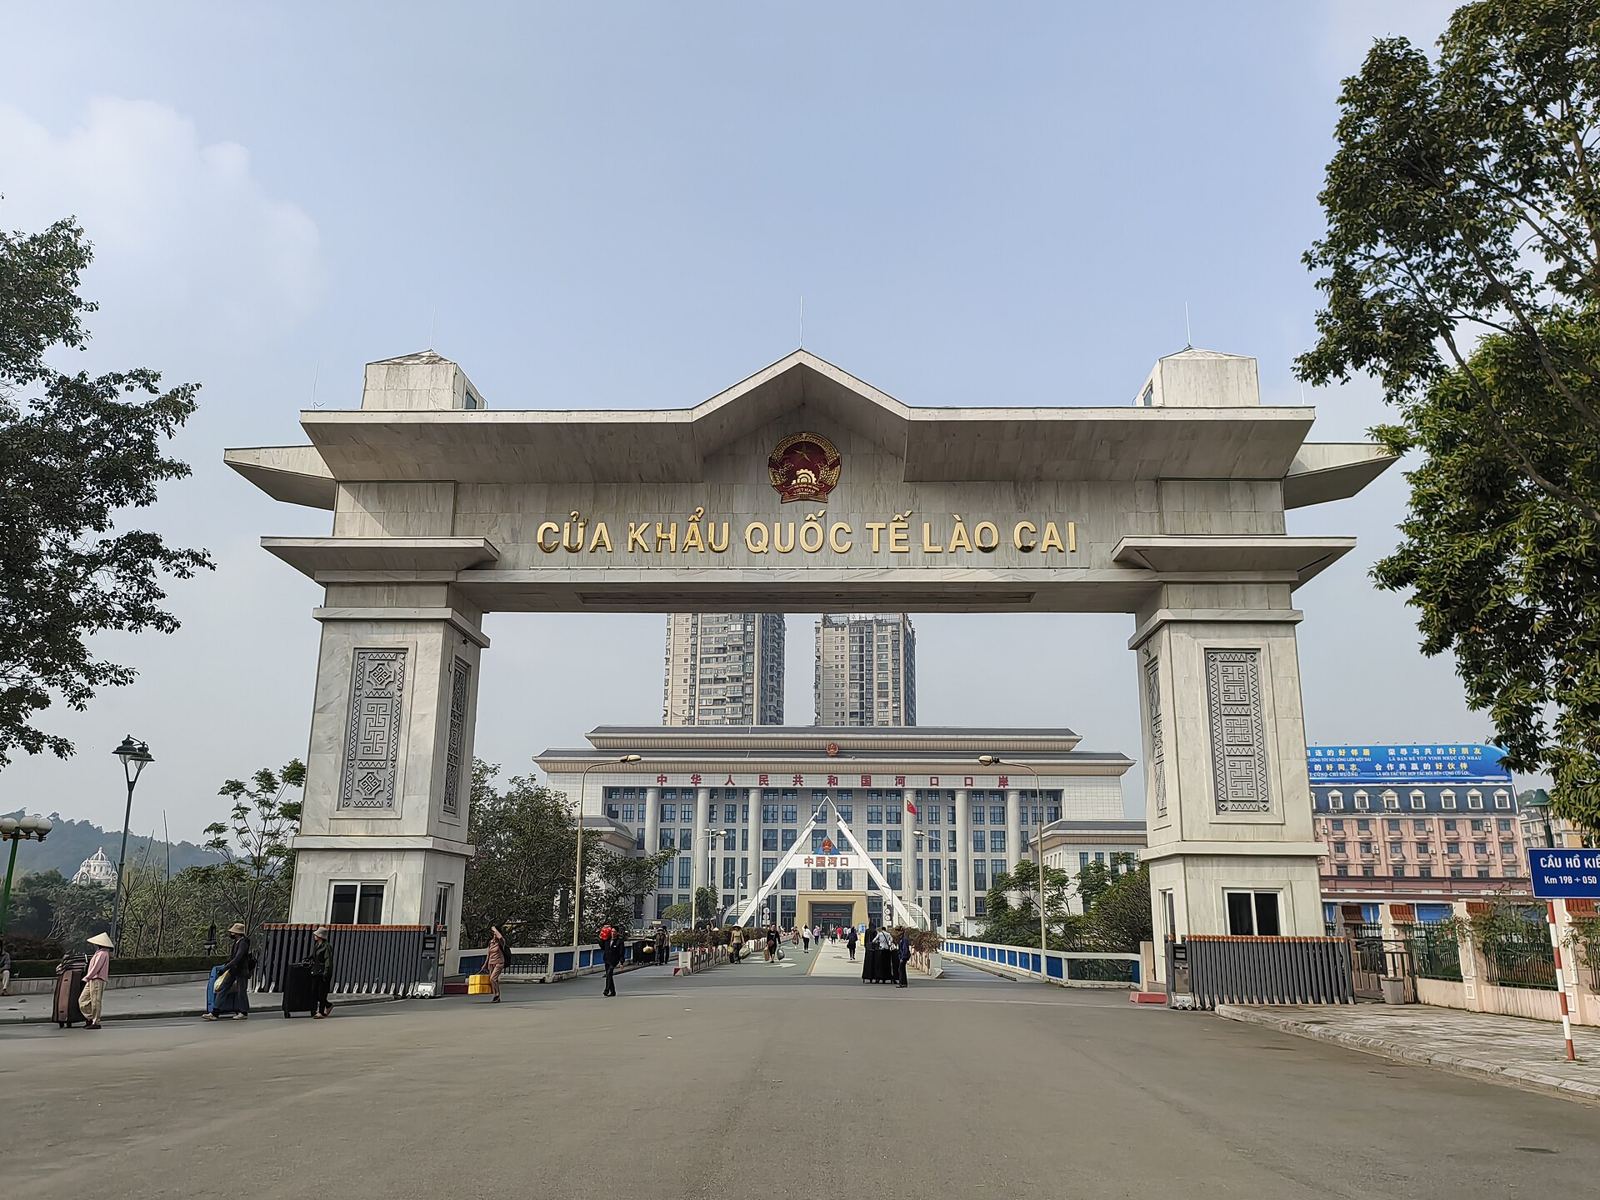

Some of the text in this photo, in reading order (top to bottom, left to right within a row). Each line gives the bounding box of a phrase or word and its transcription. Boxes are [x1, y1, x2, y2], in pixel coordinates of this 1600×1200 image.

[536, 507, 1077, 554] CỬA KHẨU QUỐC TẾ LÀO CAI
[656, 774, 1009, 788] 中华人民共和国河口口岸
[804, 856, 849, 867] 中国河口
[1540, 854, 1562, 868] CẦU
[1565, 854, 1581, 868] HỒ
[1544, 875, 1558, 884] Km
[1559, 875, 1573, 884] 198
[1582, 875, 1598, 884] 050
